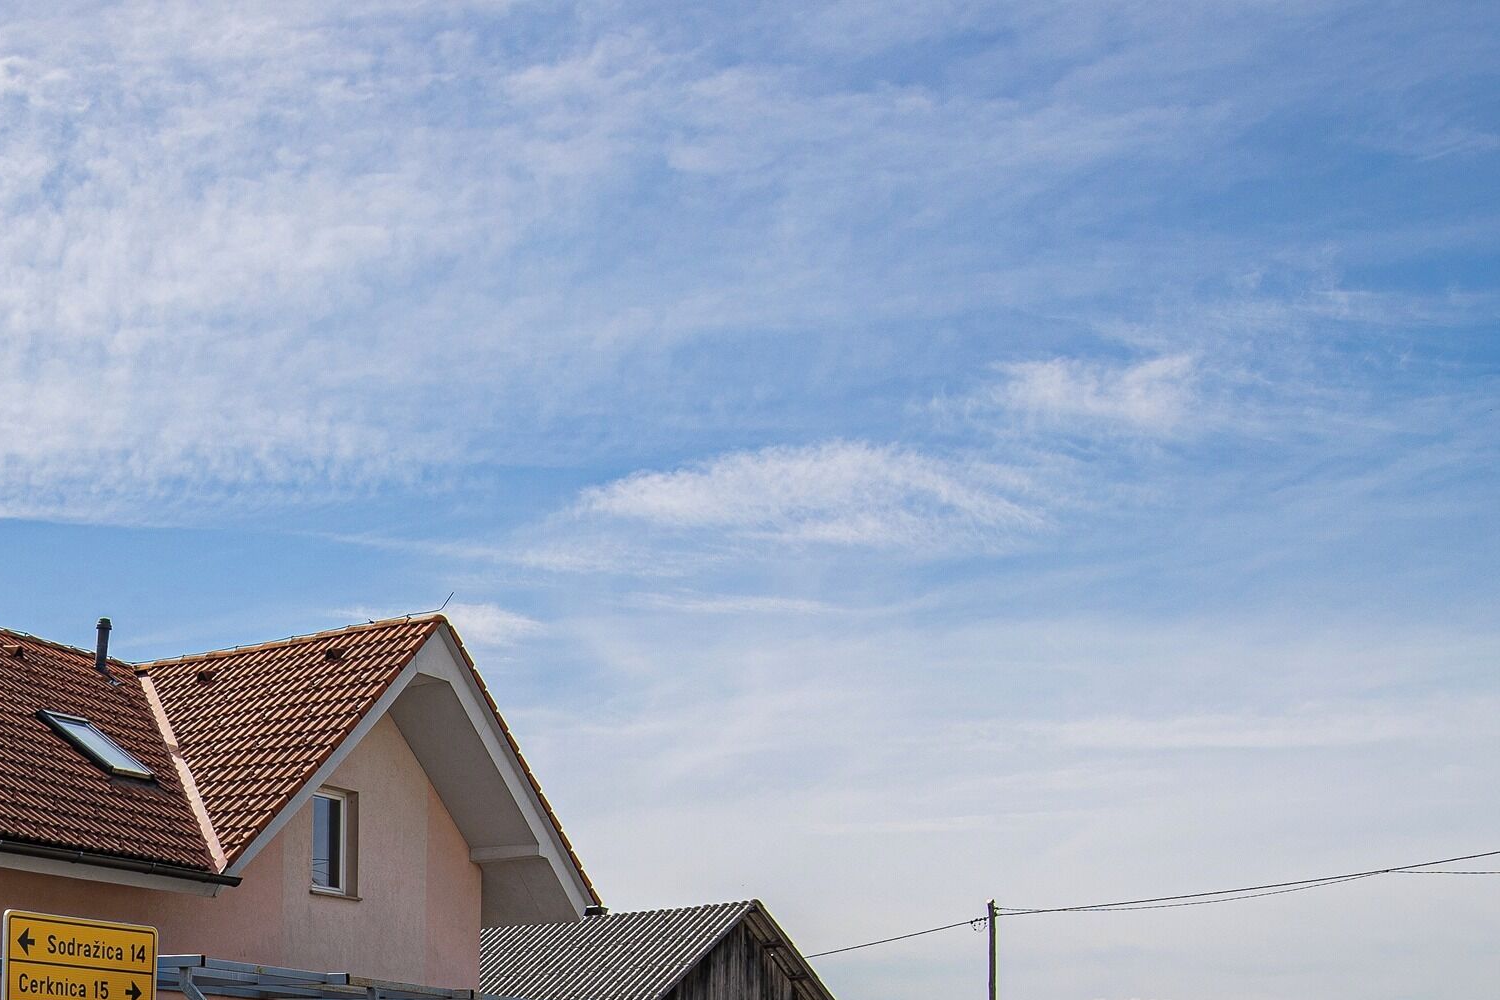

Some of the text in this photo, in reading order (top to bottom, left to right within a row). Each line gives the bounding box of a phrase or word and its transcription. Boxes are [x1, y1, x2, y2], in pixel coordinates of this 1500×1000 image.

[47, 934, 146, 963] Sodražica 14
[19, 973, 109, 1000] Cerknica 15
